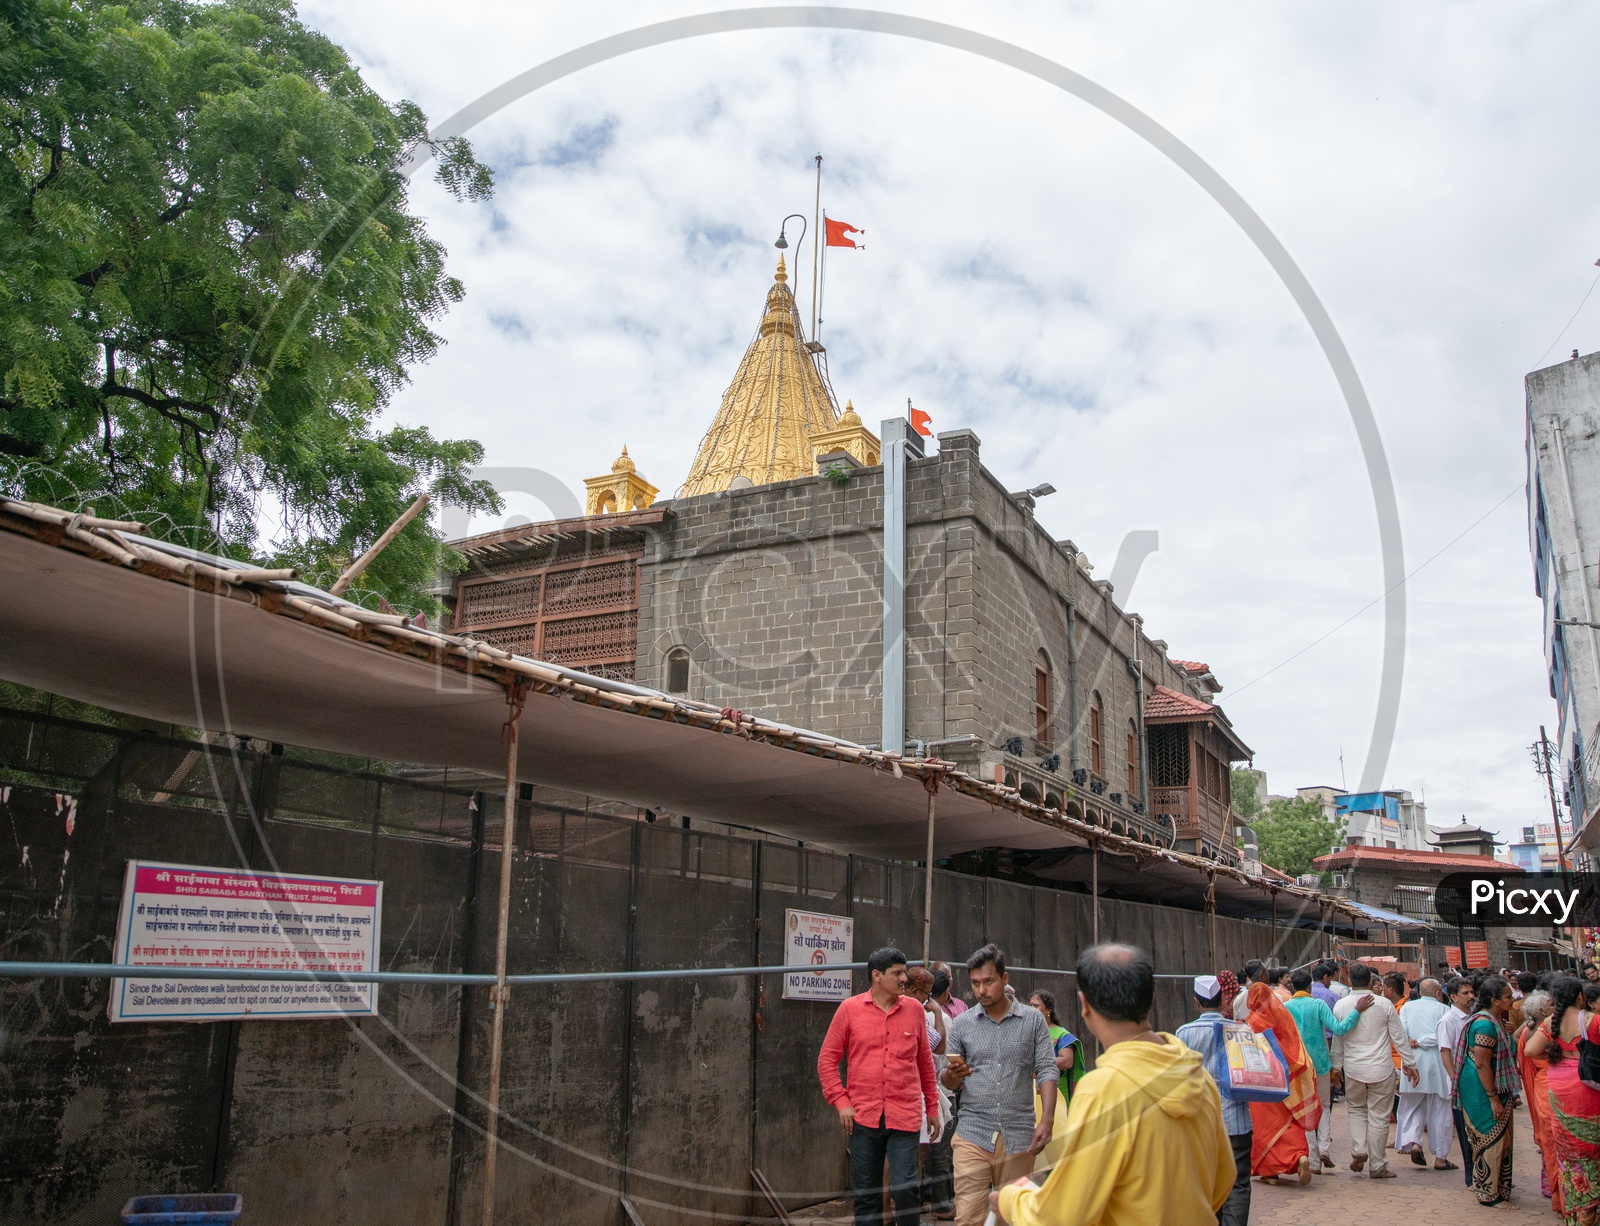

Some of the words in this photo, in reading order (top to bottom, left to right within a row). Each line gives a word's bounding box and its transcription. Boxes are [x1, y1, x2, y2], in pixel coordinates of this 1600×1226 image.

[156, 871, 170, 882] श्री
[174, 873, 220, 885] साईबाबा
[223, 876, 258, 888] संस्थान
[176, 885, 197, 894] SHRI
[199, 887, 237, 896] SAIBABA
[238, 890, 282, 899] SANSTHAN
[284, 893, 310, 901] TRUST,
[311, 895, 337, 903] SHIRDI
[136, 903, 145, 915] श्री
[147, 904, 179, 918] साईबाबांचे
[210, 909, 224, 919] पावन
[250, 911, 258, 919] या
[259, 909, 273, 920] पवित्र
[180, 922, 186, 932] व
[304, 928, 309, 936] व
[794, 932, 803, 947] नो
[831, 937, 846, 951] झोन
[132, 944, 141, 956] श्री
[143, 945, 168, 958] साईबाबा
[170, 945, 177, 956] के
[179, 945, 194, 957] पवित्र
[196, 949, 210, 957] चरण
[226, 946, 231, 957] से
[129, 983, 150, 993] Since
[151, 983, 162, 993] the
[164, 983, 176, 993] Sai
[177, 984, 209, 993] Devotees
[210, 984, 225, 993] walk
[226, 984, 260, 993] barefooted
[260, 985, 269, 993] on
[270, 984, 279, 993] the
[281, 984, 293, 995] holy
[295, 984, 307, 993] land
[308, 984, 316, 993] of
[334, 984, 356, 993] Citizens
[357, 984, 367, 993] and
[790, 976, 799, 986] NO
[802, 977, 831, 988] PARKING
[834, 979, 850, 989] ZONE
[132, 995, 145, 1006] Sai
[146, 996, 179, 1005] Devotees
[193, 996, 227, 1006] requested
[227, 996, 238, 1004] not
[239, 996, 245, 1004] to
[247, 996, 258, 1006] spit
[268, 996, 282, 1004] road
[290, 995, 319, 1006] anywhere
[320, 995, 332, 1003] else
[332, 995, 338, 1003] in
[339, 995, 348, 1003] the
